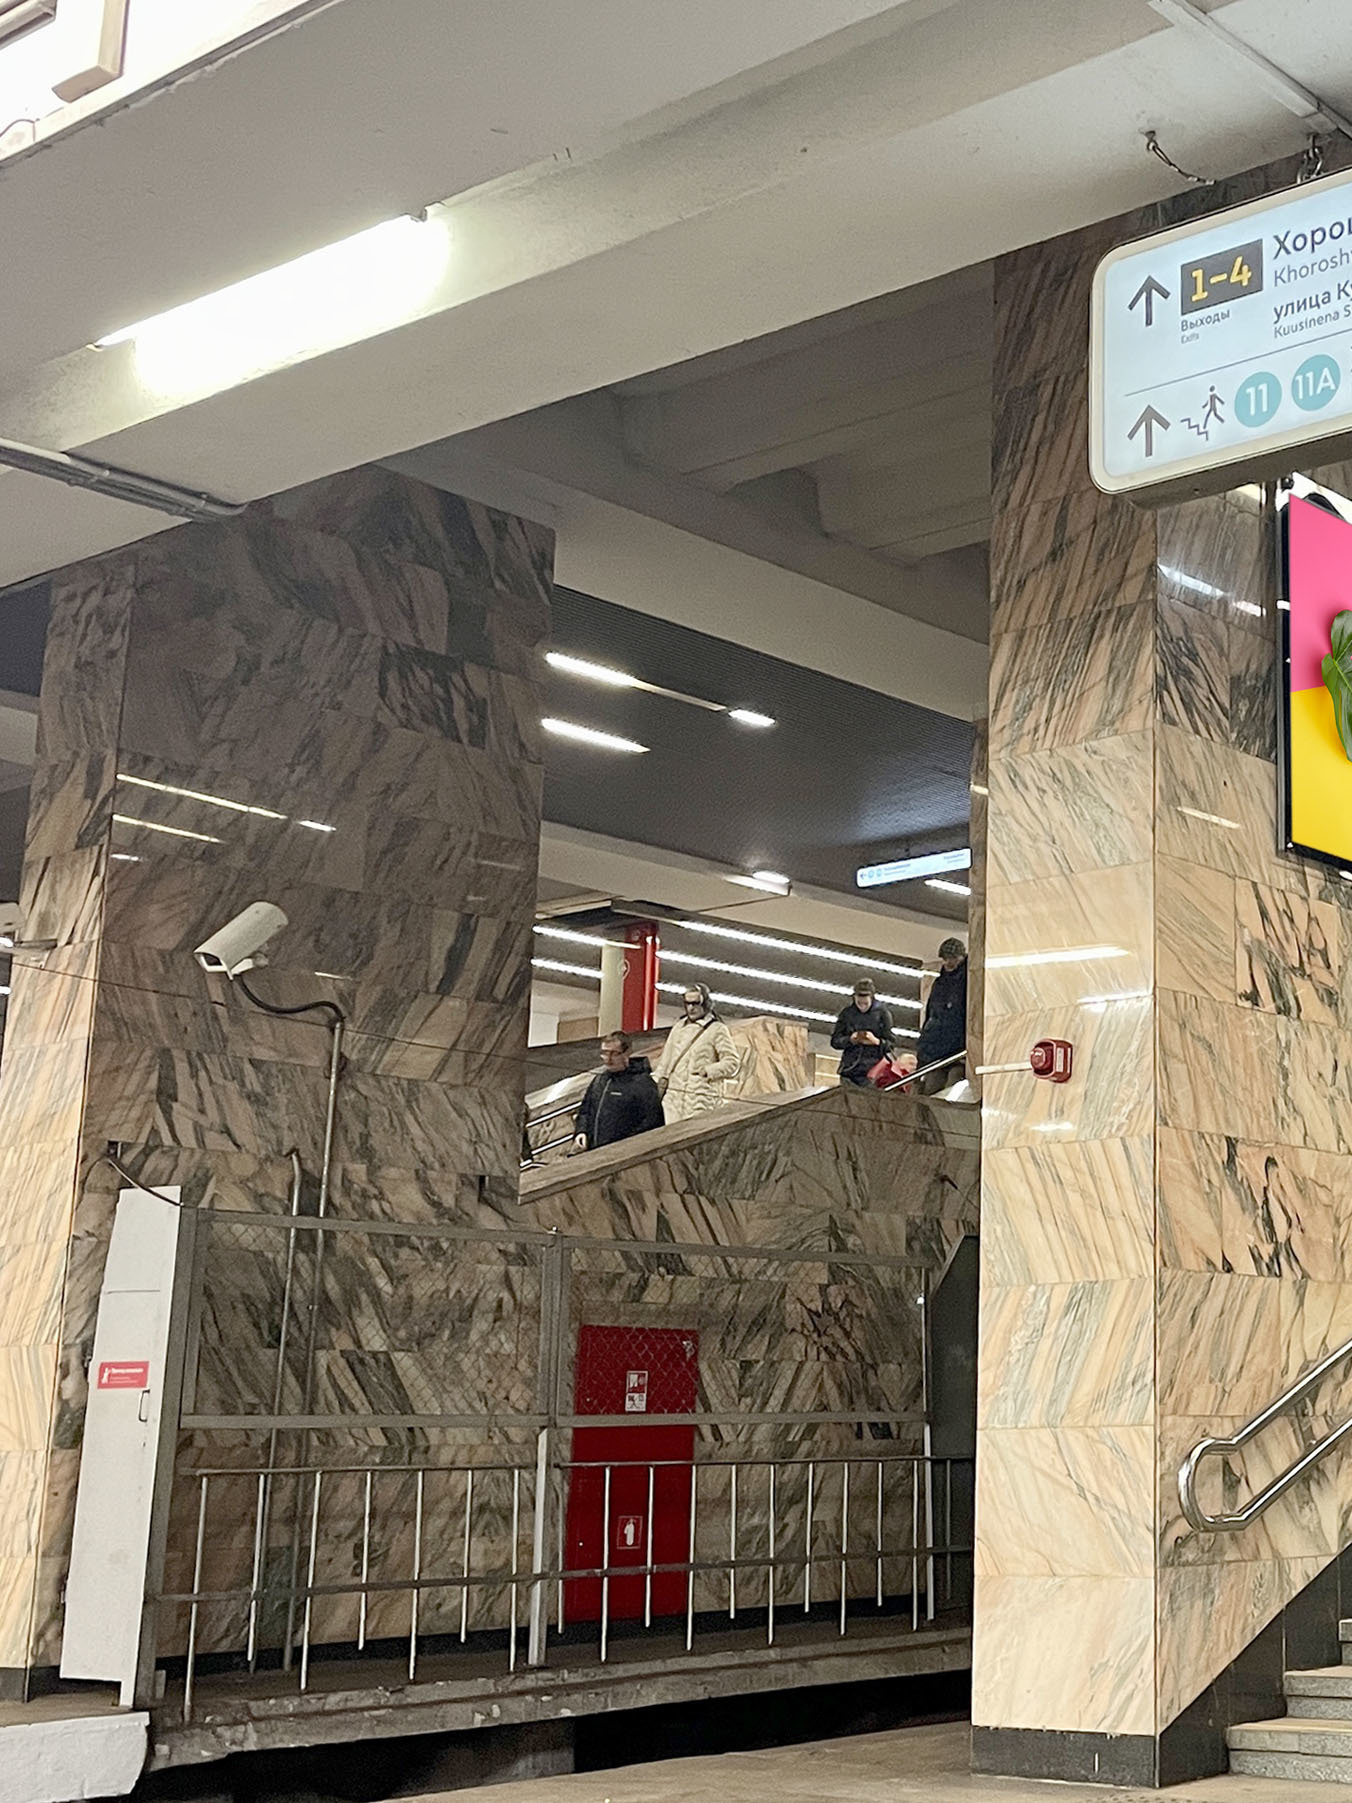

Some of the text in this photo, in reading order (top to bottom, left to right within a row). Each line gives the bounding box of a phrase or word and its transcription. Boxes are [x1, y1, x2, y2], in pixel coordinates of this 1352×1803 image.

[1181, 309, 1230, 332] Выходы
[1273, 289, 1331, 324] улица
[1273, 310, 1340, 339] Kuusinena
[1245, 382, 1269, 417] 11
